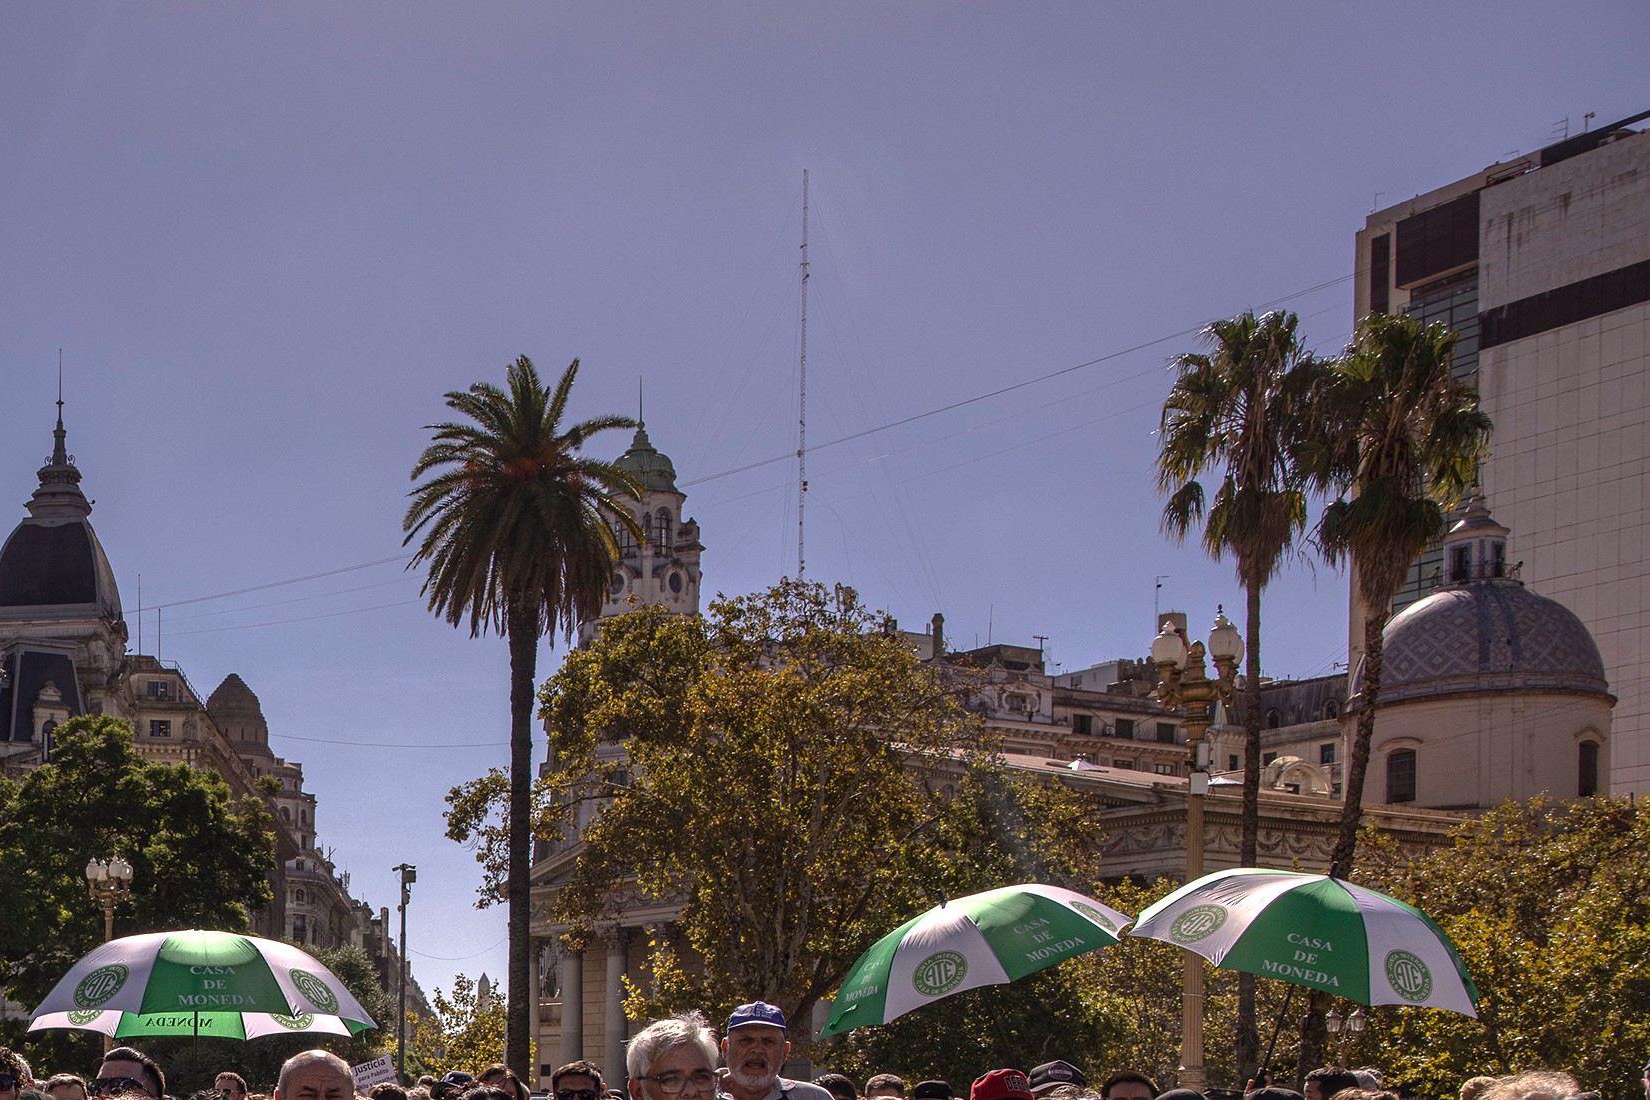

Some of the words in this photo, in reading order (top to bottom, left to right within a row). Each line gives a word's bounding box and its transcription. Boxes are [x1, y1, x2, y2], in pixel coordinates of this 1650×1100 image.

[1013, 917, 1051, 936] CASA
[1032, 929, 1054, 943] DE
[1287, 932, 1333, 952] CASA
[1025, 936, 1085, 963] MONEDA
[1293, 949, 1318, 964] DE
[190, 965, 236, 975] CASA
[1261, 959, 1341, 987] MONEDA
[202, 979, 227, 990] DE
[178, 994, 256, 1006] MONEDA
[354, 1058, 386, 1077] Justicia
[358, 1074, 370, 1082] para
